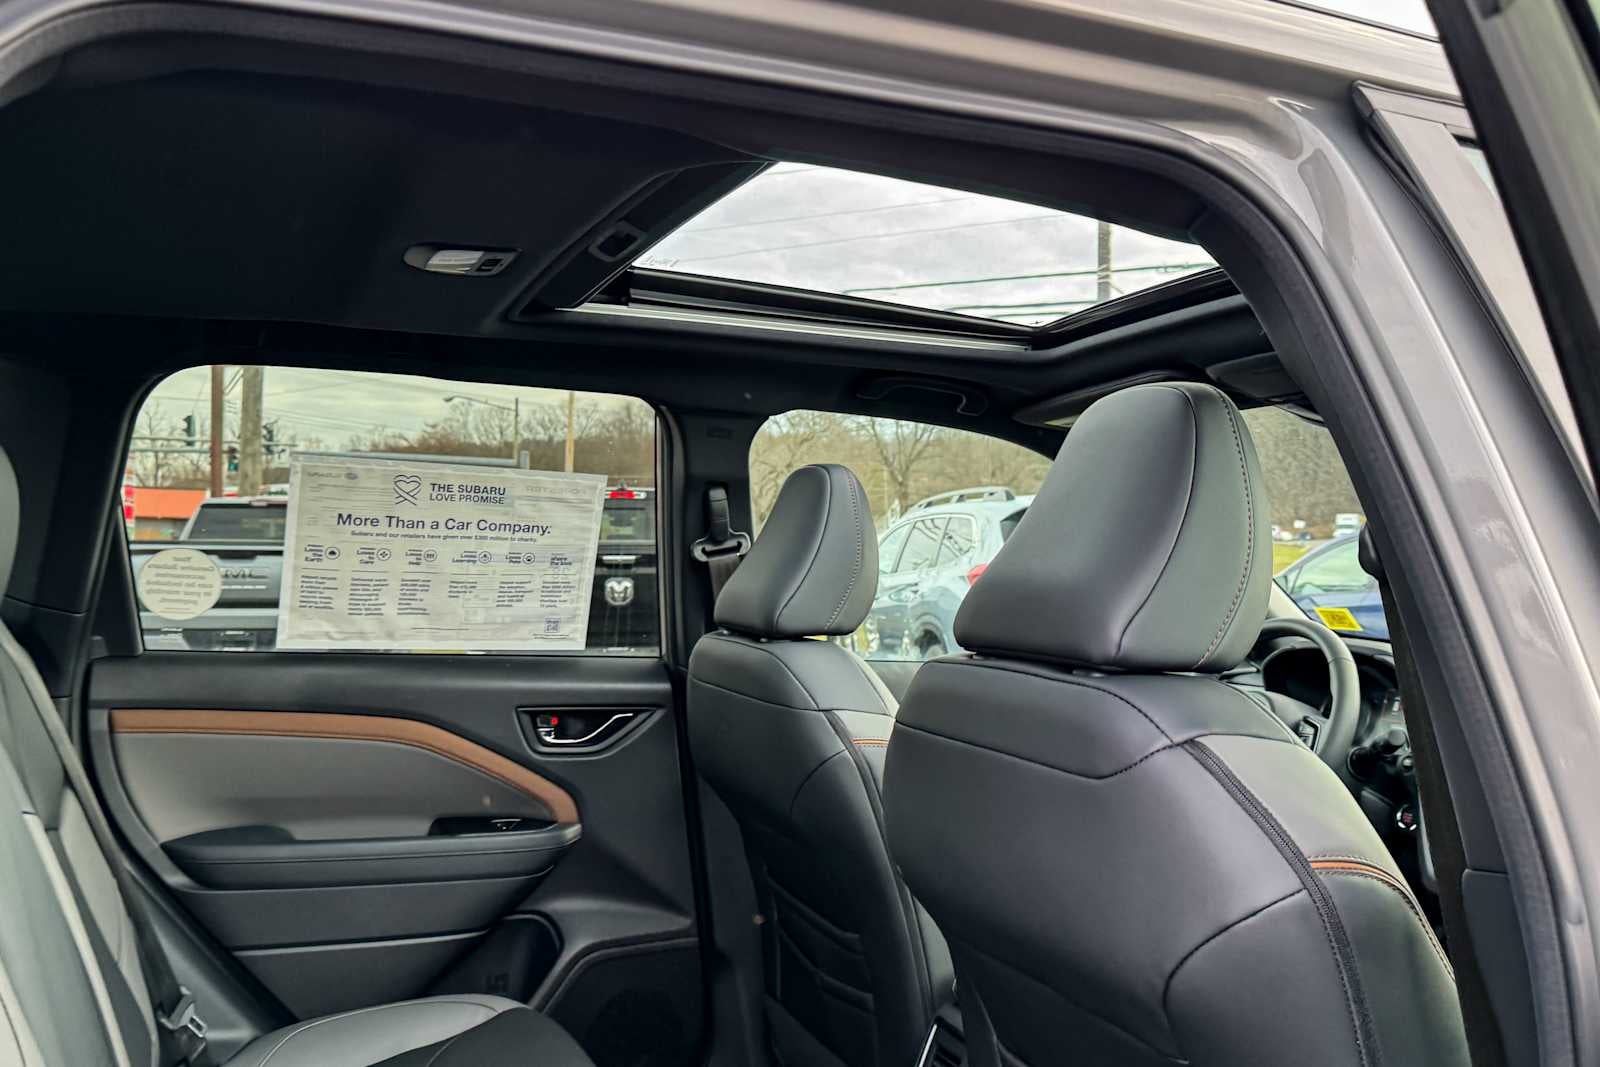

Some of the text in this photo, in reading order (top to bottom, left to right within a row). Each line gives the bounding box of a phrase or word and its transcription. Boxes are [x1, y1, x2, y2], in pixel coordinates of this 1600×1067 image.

[431, 483, 506, 496] THE SUBARU
[429, 493, 505, 505] LOVE PROMISE
[336, 513, 552, 536] More Than a Car Company.
[401, 532, 425, 540] retailers
[442, 534, 459, 542] given
